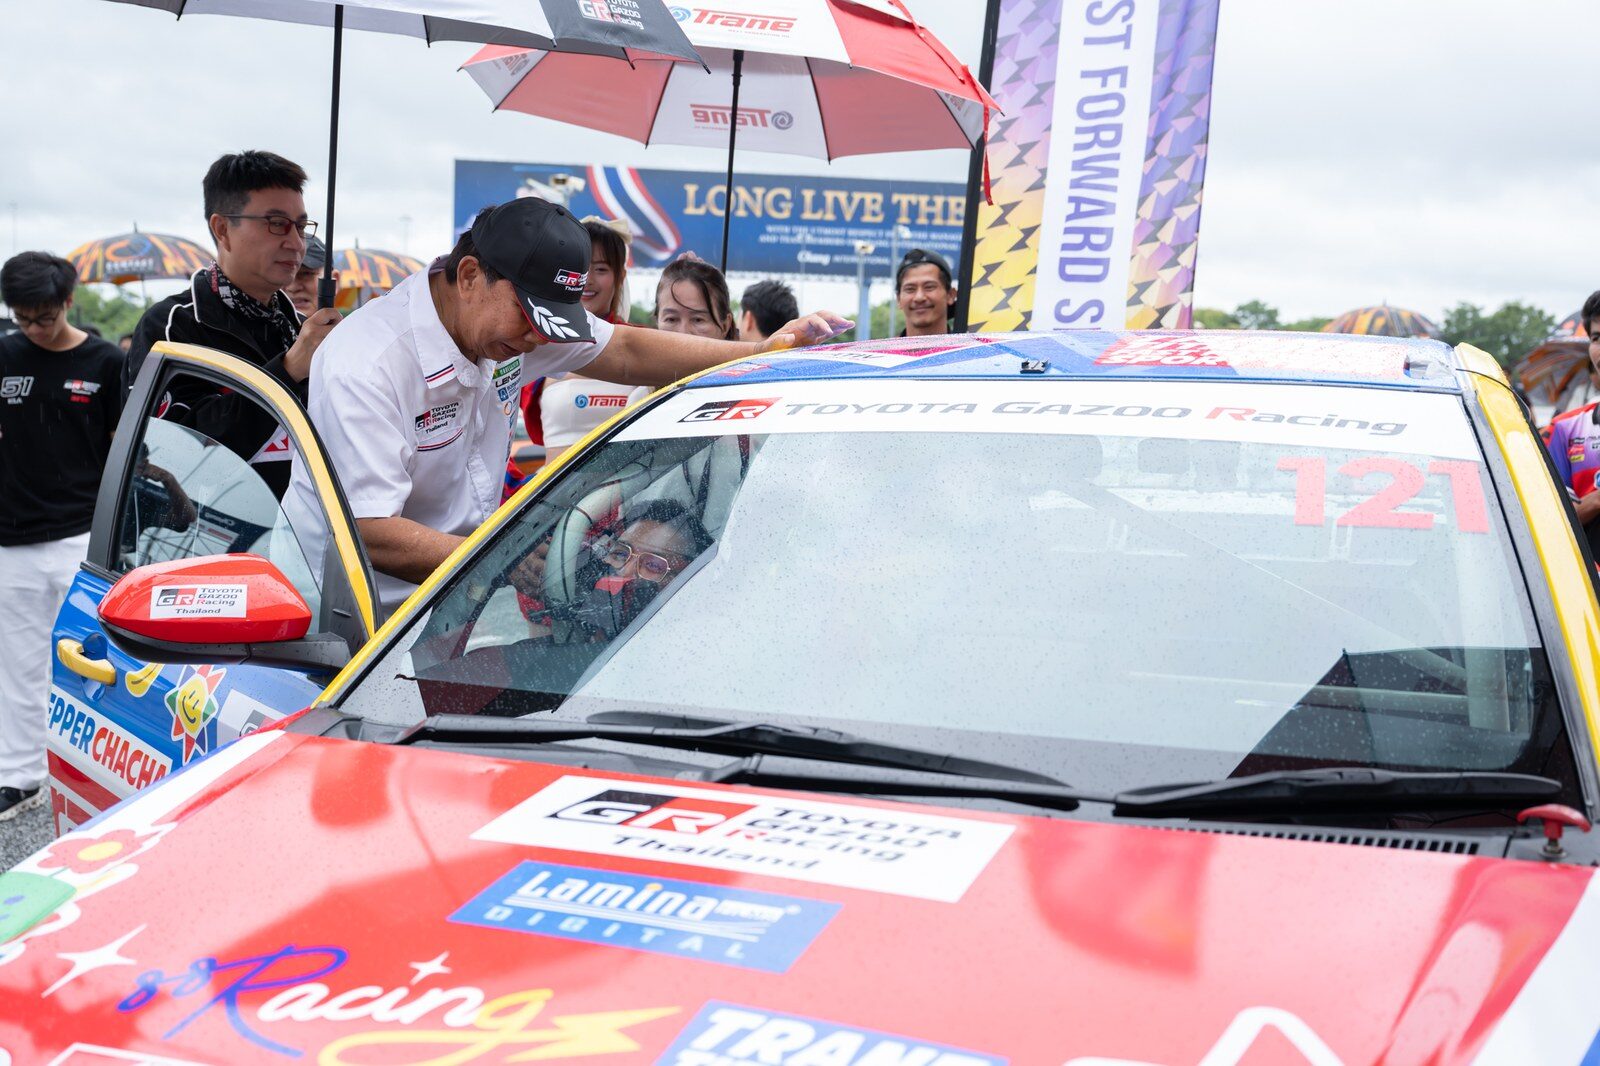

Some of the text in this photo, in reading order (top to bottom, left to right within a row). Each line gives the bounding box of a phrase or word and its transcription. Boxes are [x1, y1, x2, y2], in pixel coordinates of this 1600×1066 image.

[578, 0, 613, 22] GR
[610, 4, 642, 19] GAZOO
[613, 13, 645, 30] Racing
[693, 8, 798, 33] Trane
[1053, 0, 1136, 330] ST FORWARD S
[683, 183, 966, 227] LONG LIVE THE
[431, 402, 459, 413] TOYOTA
[431, 407, 457, 418] GAZOO
[588, 395, 628, 407] Trane
[432, 413, 456, 424] Racing
[680, 401, 1408, 436] GR TOYOTA GAZOO Racing
[1276, 454, 1491, 534] 121
[157, 590, 196, 607] GR
[552, 795, 732, 835] GR
[774, 807, 962, 840] TOYOTA
[725, 829, 906, 862] Racing
[746, 818, 929, 848] GAZOO
[613, 833, 821, 869] Thailand
[514, 870, 719, 922] Lamina
[483, 904, 746, 960] DIGITAL
